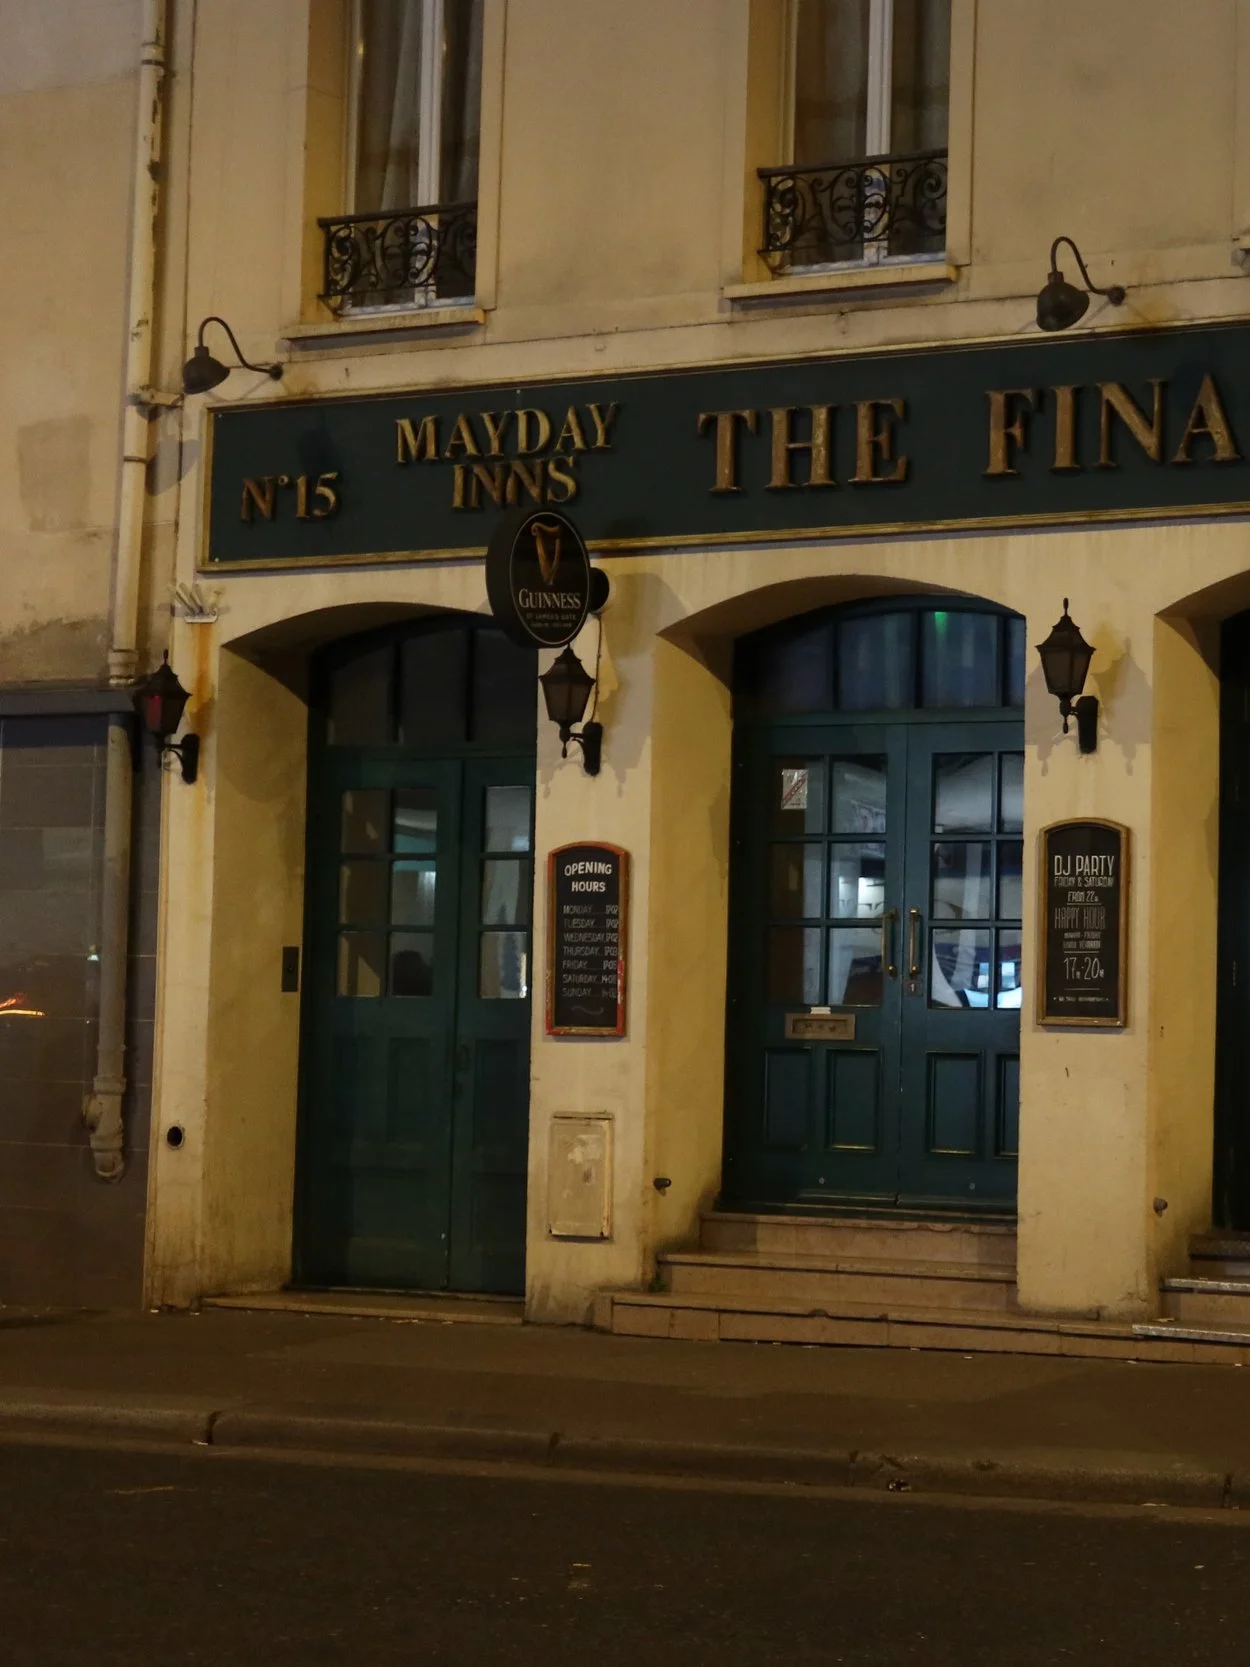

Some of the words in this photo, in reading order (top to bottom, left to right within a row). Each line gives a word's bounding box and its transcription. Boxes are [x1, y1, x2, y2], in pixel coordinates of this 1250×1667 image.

[395, 402, 620, 464] MAYDAY
[698, 399, 910, 493] THE
[451, 456, 579, 509] INNS
[518, 587, 581, 610] GUINNESS
[564, 861, 612, 877] OPENING
[1053, 855, 1070, 875] DJ
[1076, 855, 1114, 875] PARTY
[571, 881, 606, 893] HOURS
[1054, 906, 1079, 929] HAPPY
[1083, 906, 1106, 929] HOUR
